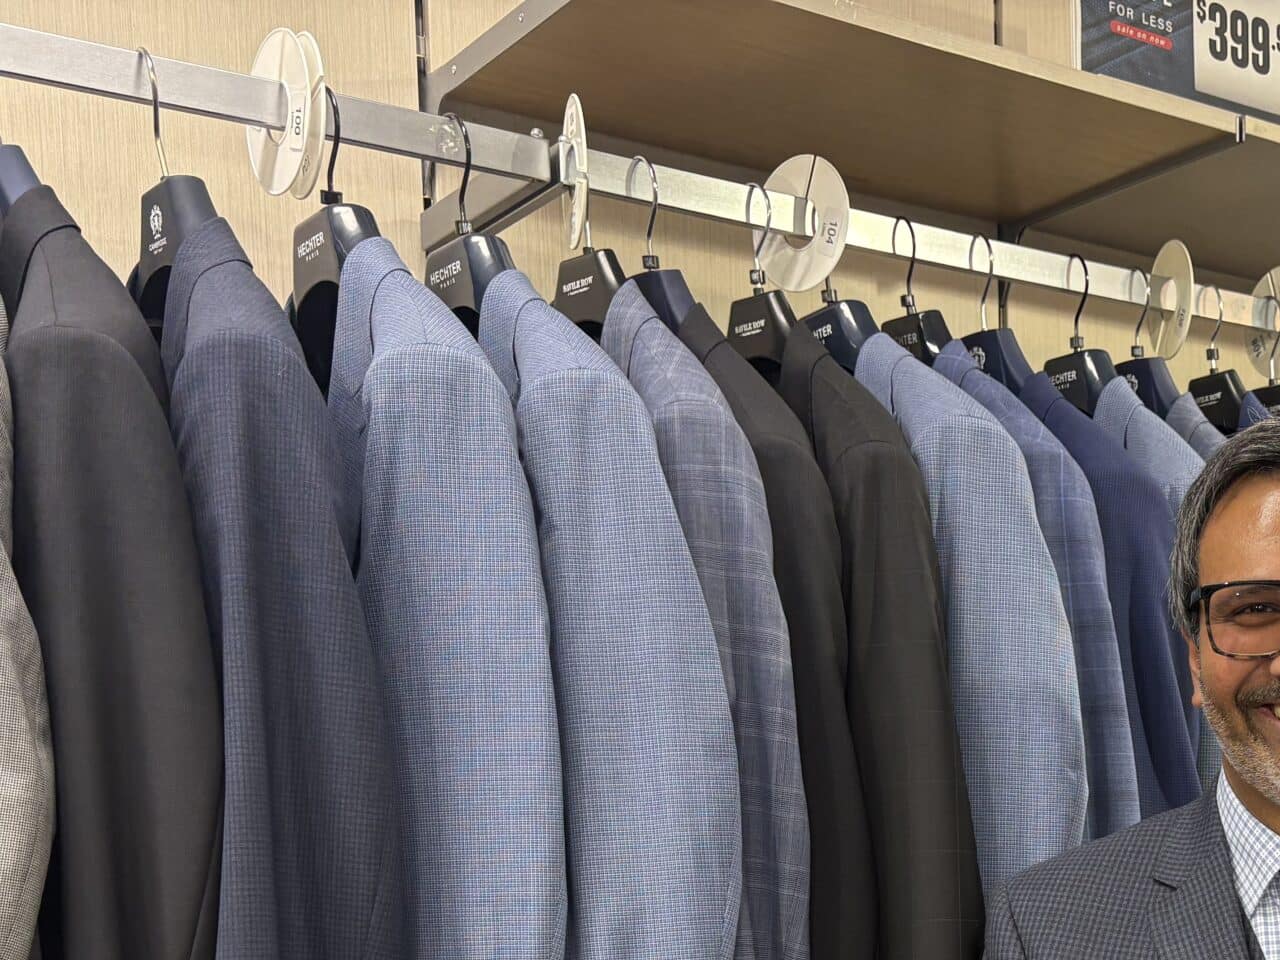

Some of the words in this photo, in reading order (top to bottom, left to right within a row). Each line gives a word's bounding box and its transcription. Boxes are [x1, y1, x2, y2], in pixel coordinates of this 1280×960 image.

[1109, 1, 1134, 20] FOR
[1142, 11, 1173, 33] LESS
[1117, 24, 1134, 39] sale
[1136, 30, 1148, 40] on
[1149, 34, 1166, 46] now
[294, 109, 302, 136] 100
[297, 232, 325, 258] HECHTER
[825, 221, 838, 245] 104
[430, 260, 462, 285] HECHTER
[814, 324, 832, 340] HTER
[1051, 371, 1077, 385] ECHTER
